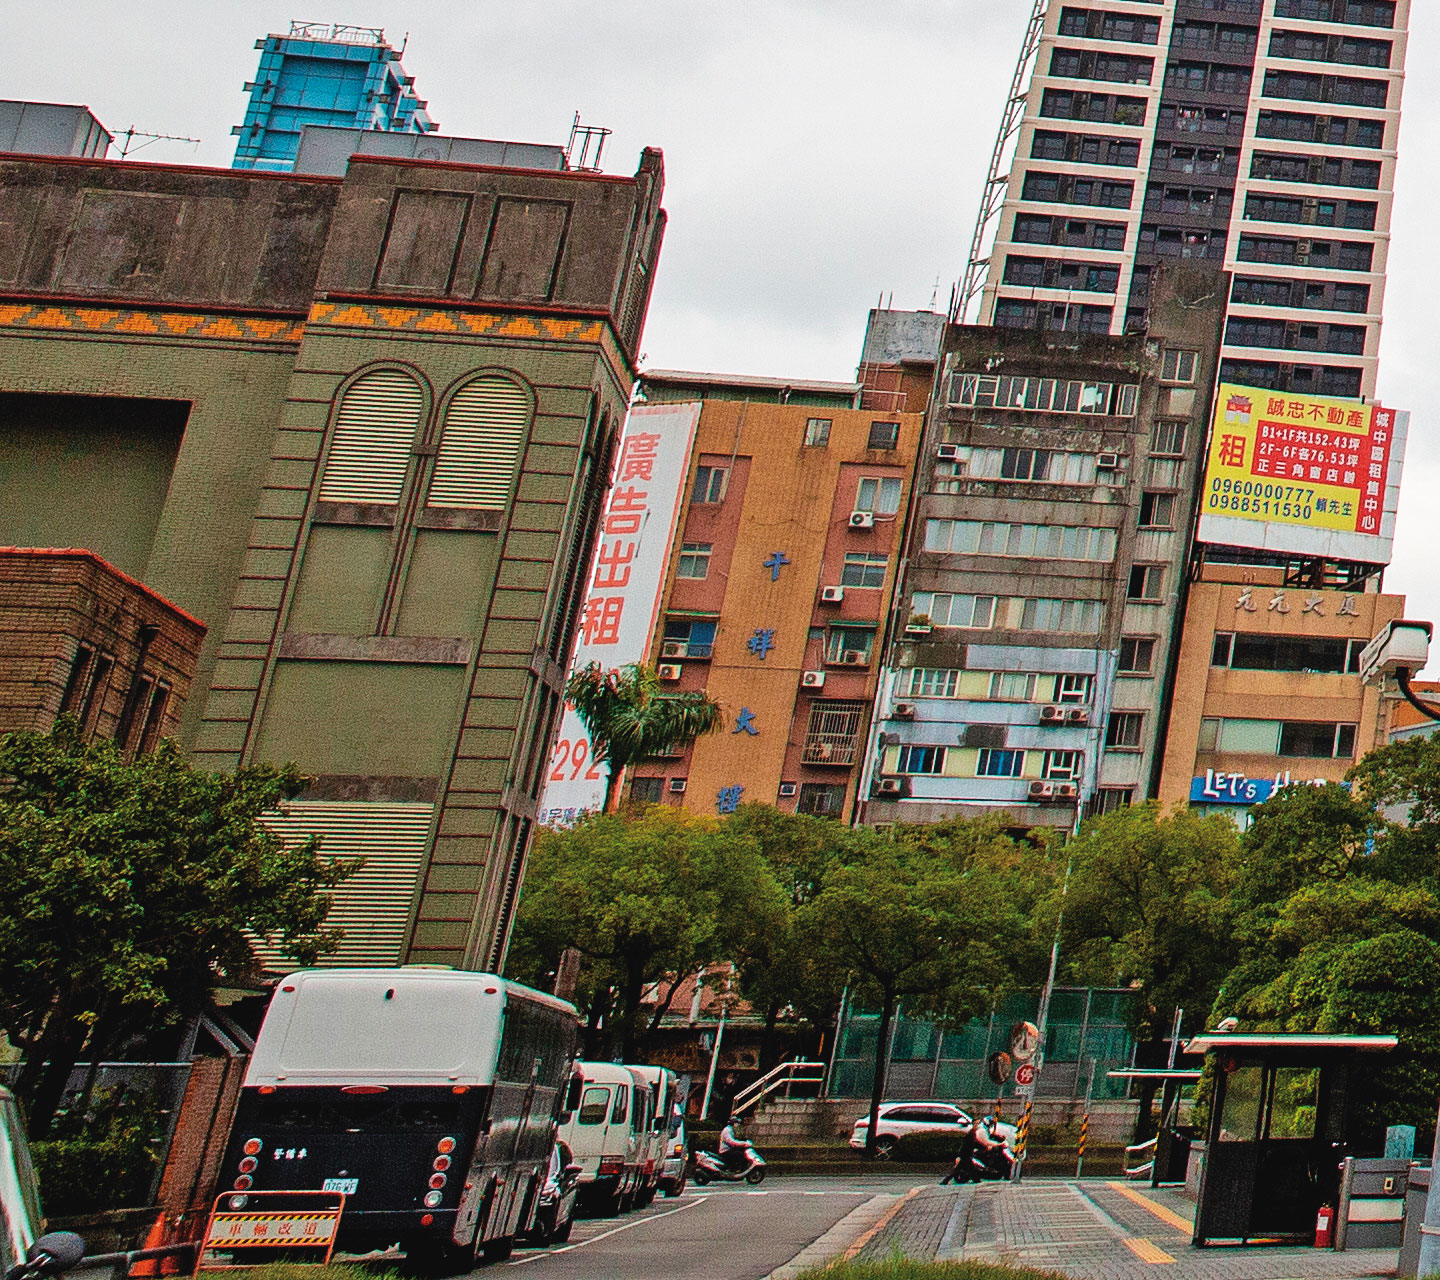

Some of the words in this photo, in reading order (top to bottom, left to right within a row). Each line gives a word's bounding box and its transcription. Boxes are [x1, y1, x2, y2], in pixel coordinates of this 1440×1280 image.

[1218, 433, 1247, 469] 租
[1211, 477, 1315, 504] 0960000777
[1209, 493, 1312, 520] 0988511530
[582, 432, 661, 647] 廣告出租
